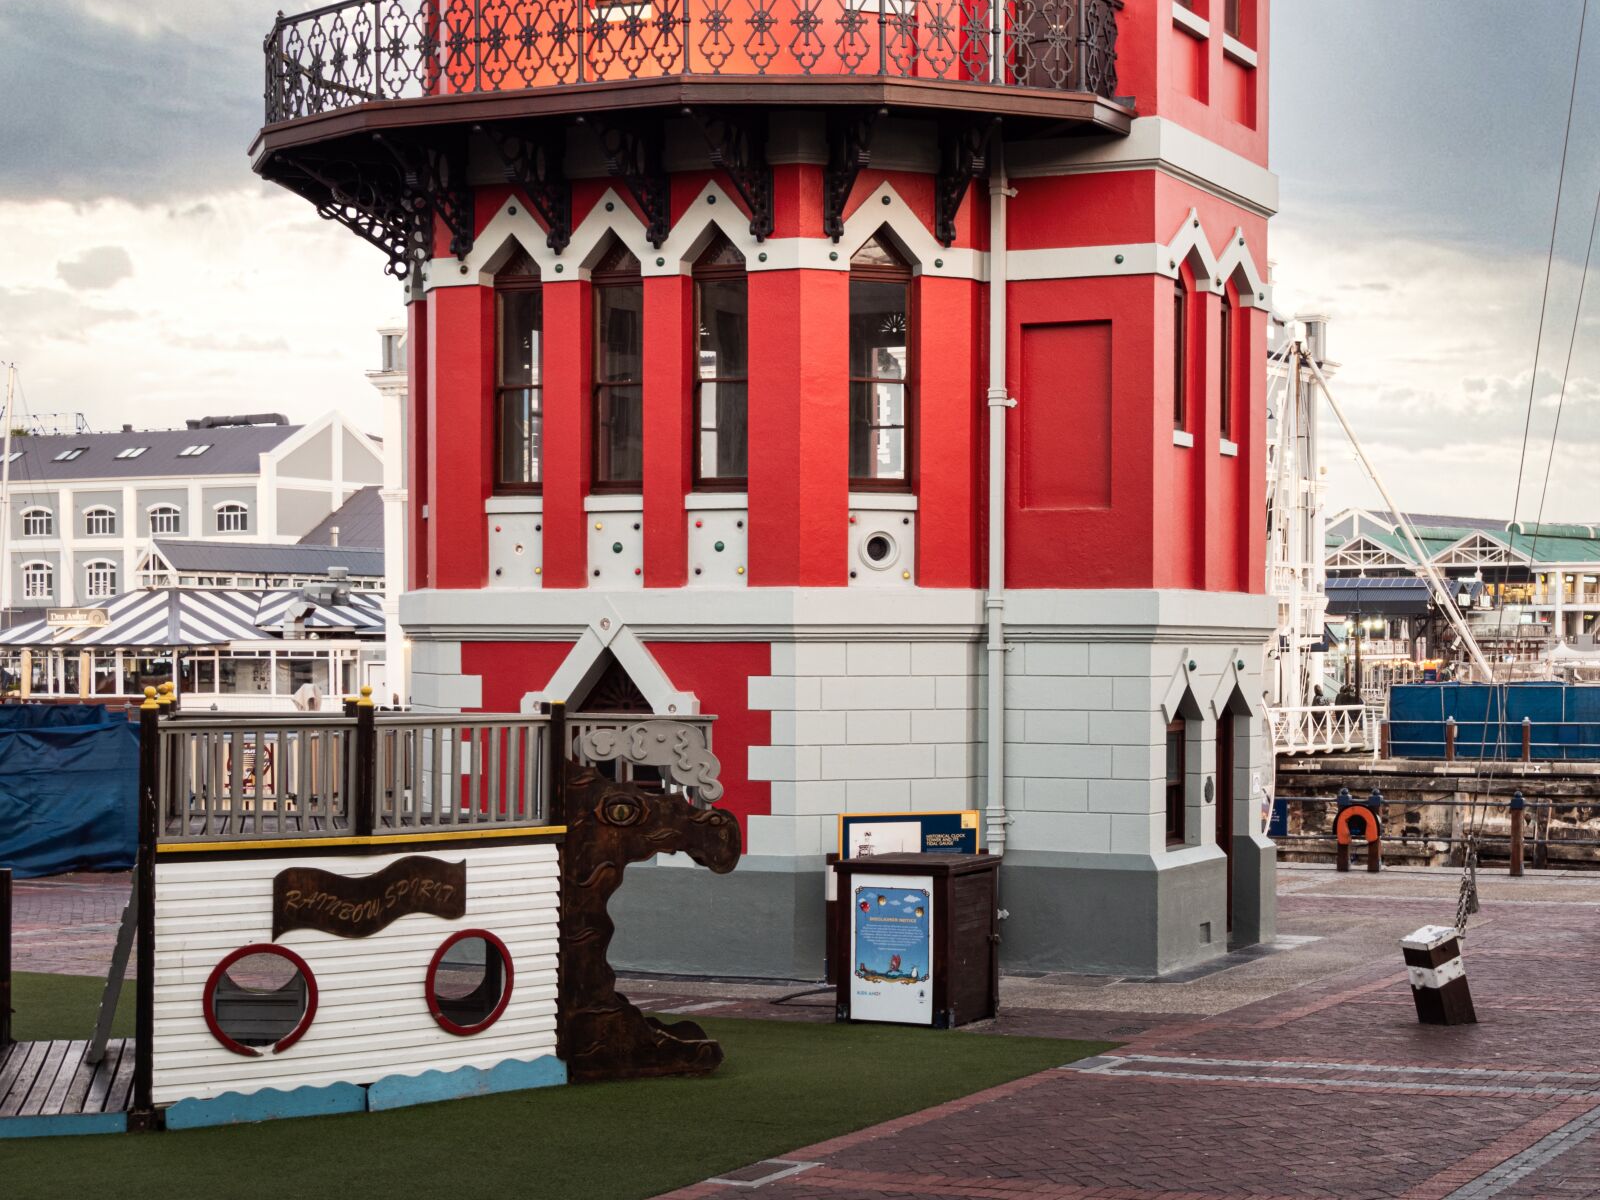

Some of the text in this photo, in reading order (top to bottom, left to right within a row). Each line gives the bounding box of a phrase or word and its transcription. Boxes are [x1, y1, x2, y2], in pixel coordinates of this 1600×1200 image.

[51, 612, 65, 620] Den
[285, 878, 454, 922] RAINBOW SPIRIT
